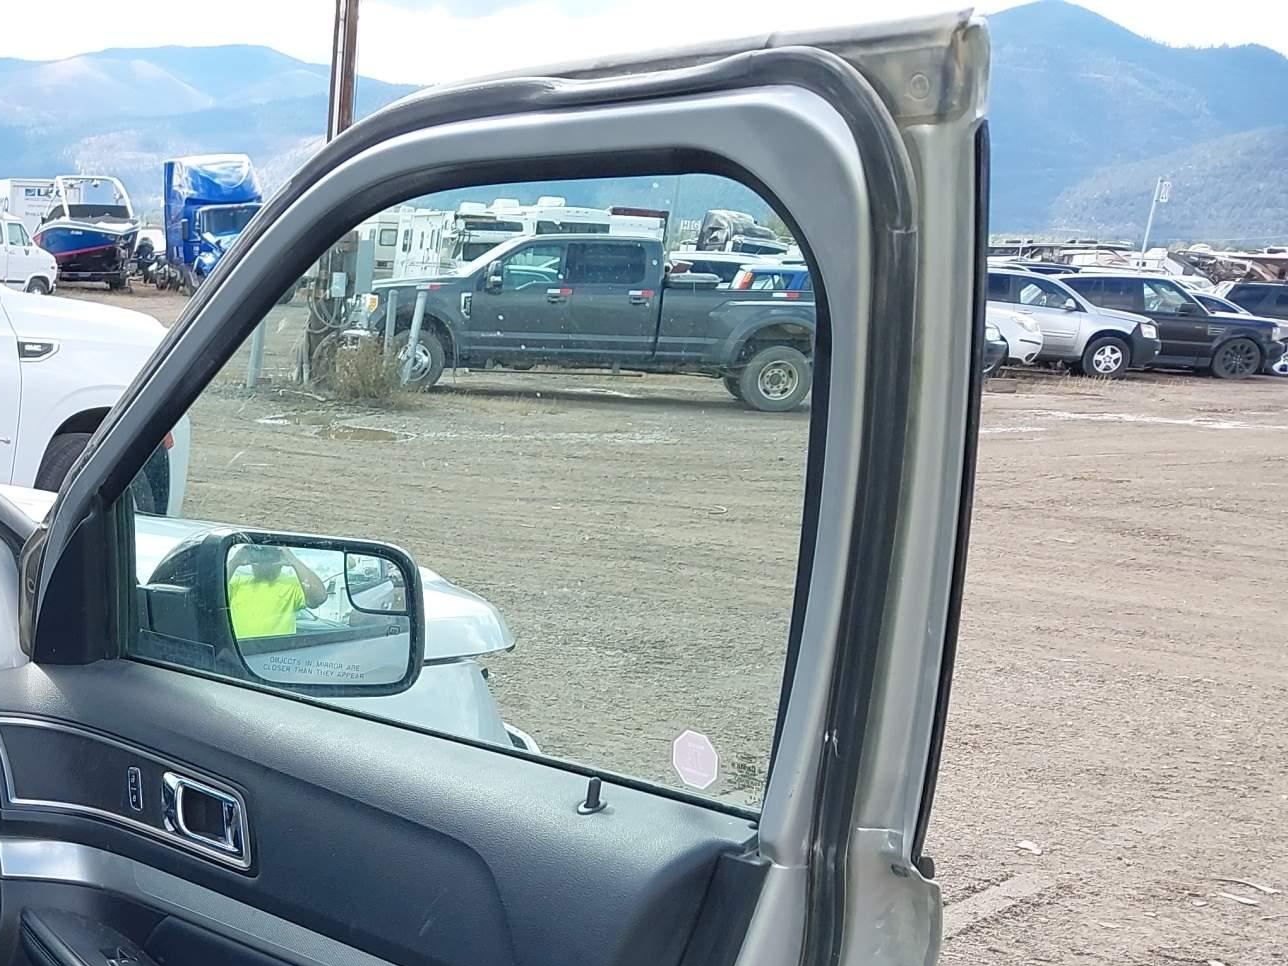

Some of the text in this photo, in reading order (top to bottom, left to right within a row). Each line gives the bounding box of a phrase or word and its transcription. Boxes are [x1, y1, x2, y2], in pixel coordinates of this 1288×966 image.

[262, 663, 365, 680] CLOSER THAN THEY APPEAR
[269, 655, 301, 666] OBJECTS
[316, 660, 343, 670] MIRROR
[346, 664, 361, 672] ARE
